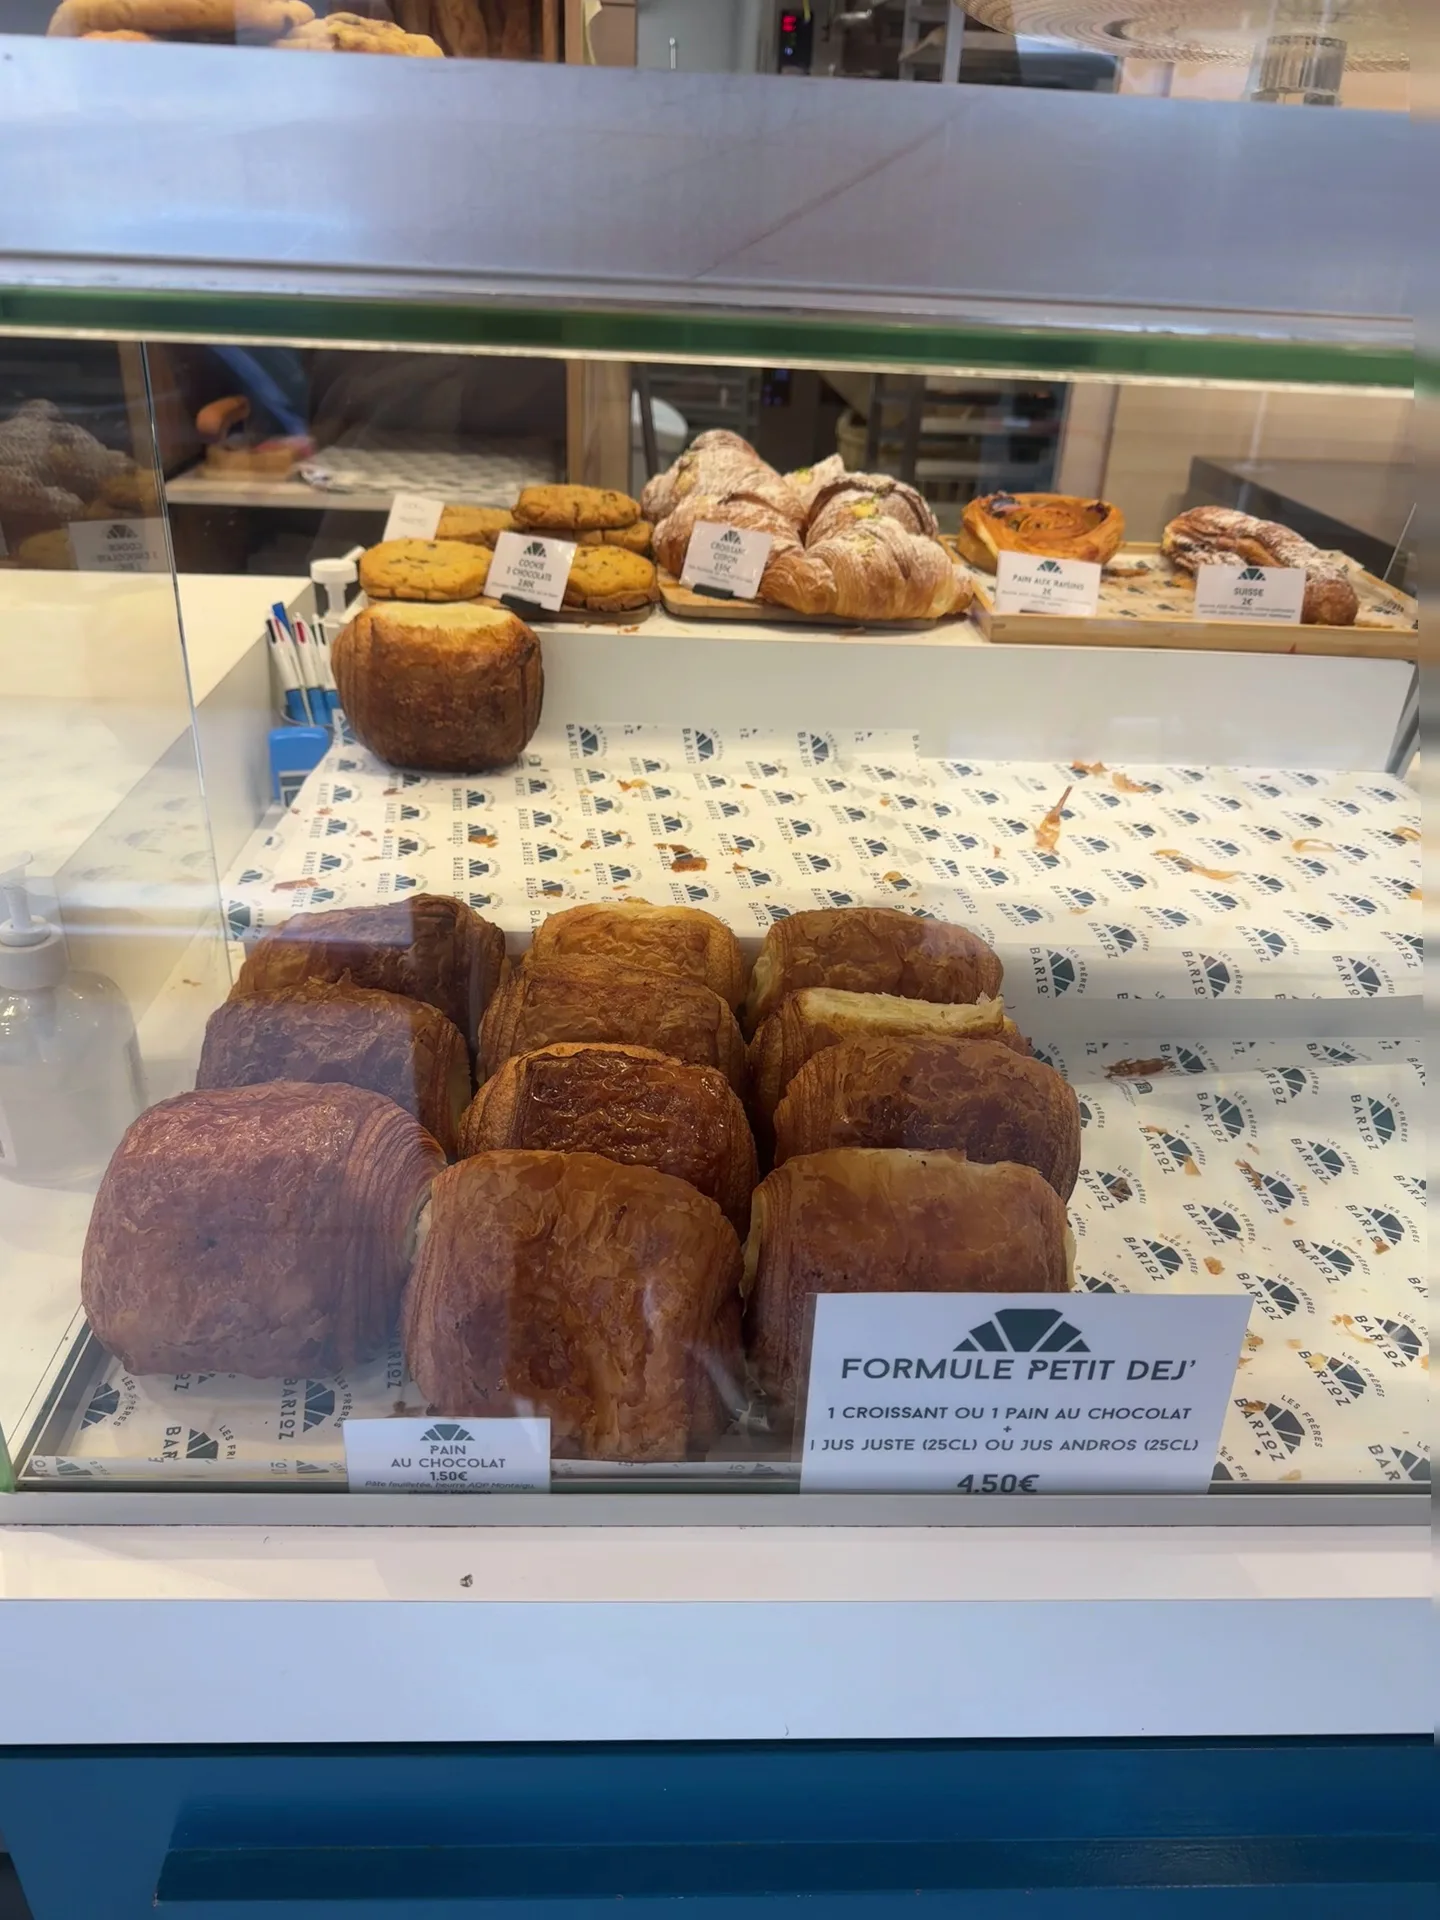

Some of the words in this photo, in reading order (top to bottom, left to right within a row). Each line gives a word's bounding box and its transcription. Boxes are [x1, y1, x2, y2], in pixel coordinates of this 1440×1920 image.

[1234, 587, 1264, 597] SUISSE
[1088, 922, 1119, 959] BARIOZ
[1235, 926, 1270, 962] BARIOZ
[1065, 947, 1079, 959] LES
[1218, 951, 1232, 961] LES
[1029, 947, 1050, 999] BARIO
[1182, 951, 1209, 1000] BARIO
[1332, 955, 1365, 1000] BARIO
[1078, 1093, 1092, 1102] LES
[1233, 1091, 1247, 1106] LES
[1386, 1093, 1400, 1107] LES
[1197, 1092, 1228, 1144] BARIOZ
[1351, 1093, 1380, 1150] BARIOZ
[1139, 1127, 1175, 1175] BARIOZ
[1291, 1138, 1331, 1182] BARIOZ
[1117, 1165, 1132, 1177] LES
[1275, 1170, 1291, 1182] LES
[1079, 1169, 1115, 1211] BARIOZ
[1222, 1200, 1239, 1212] LES
[1384, 1204, 1400, 1214] LES
[1183, 1204, 1226, 1246] BARIOZ
[1164, 1236, 1181, 1247] LES
[1123, 1237, 1165, 1281] BARIOZ
[1293, 1239, 1340, 1284] BARIOZ
[1102, 1271, 1119, 1283] LES
[1277, 1273, 1294, 1286] LES
[1236, 1272, 1283, 1321] BARIOZ
[1397, 1311, 1415, 1324] LES
[1354, 1315, 1407, 1368] BARIOZ
[1341, 1352, 1360, 1365] LES
[841, 1358, 1014, 1380] FORMULE
[1027, 1358, 1116, 1381] PETIT
[121, 1376, 136, 1391] LES
[827, 1407, 834, 1419] 1
[842, 1406, 948, 1420] CROISSANT
[955, 1407, 985, 1420] OU
[991, 1407, 998, 1419] 1
[1005, 1407, 1049, 1420] PAIN
[1055, 1407, 1080, 1420] AU
[1087, 1407, 1191, 1420] CHOCOLAT
[1280, 1394, 1300, 1410] LES
[1302, 1411, 1323, 1448] FRÈRES
[219, 1424, 235, 1441] LES
[1003, 1425, 1012, 1433] +
[1233, 1397, 1286, 1462] BARIOZ
[430, 1445, 466, 1455] PAIN
[822, 1439, 854, 1451] JUS
[861, 1439, 915, 1451] JUSTE
[922, 1438, 978, 1452] (25CL)
[985, 1439, 1014, 1452] OU
[1020, 1439, 1053, 1452] JUS
[1060, 1439, 1137, 1452] ANDROS
[1144, 1439, 1200, 1452] (25CL)
[391, 1458, 412, 1468] AU
[419, 1458, 506, 1468] CHOCOLAT
[430, 1471, 468, 1481] 1.50€
[957, 1474, 1040, 1494] 4.50€
